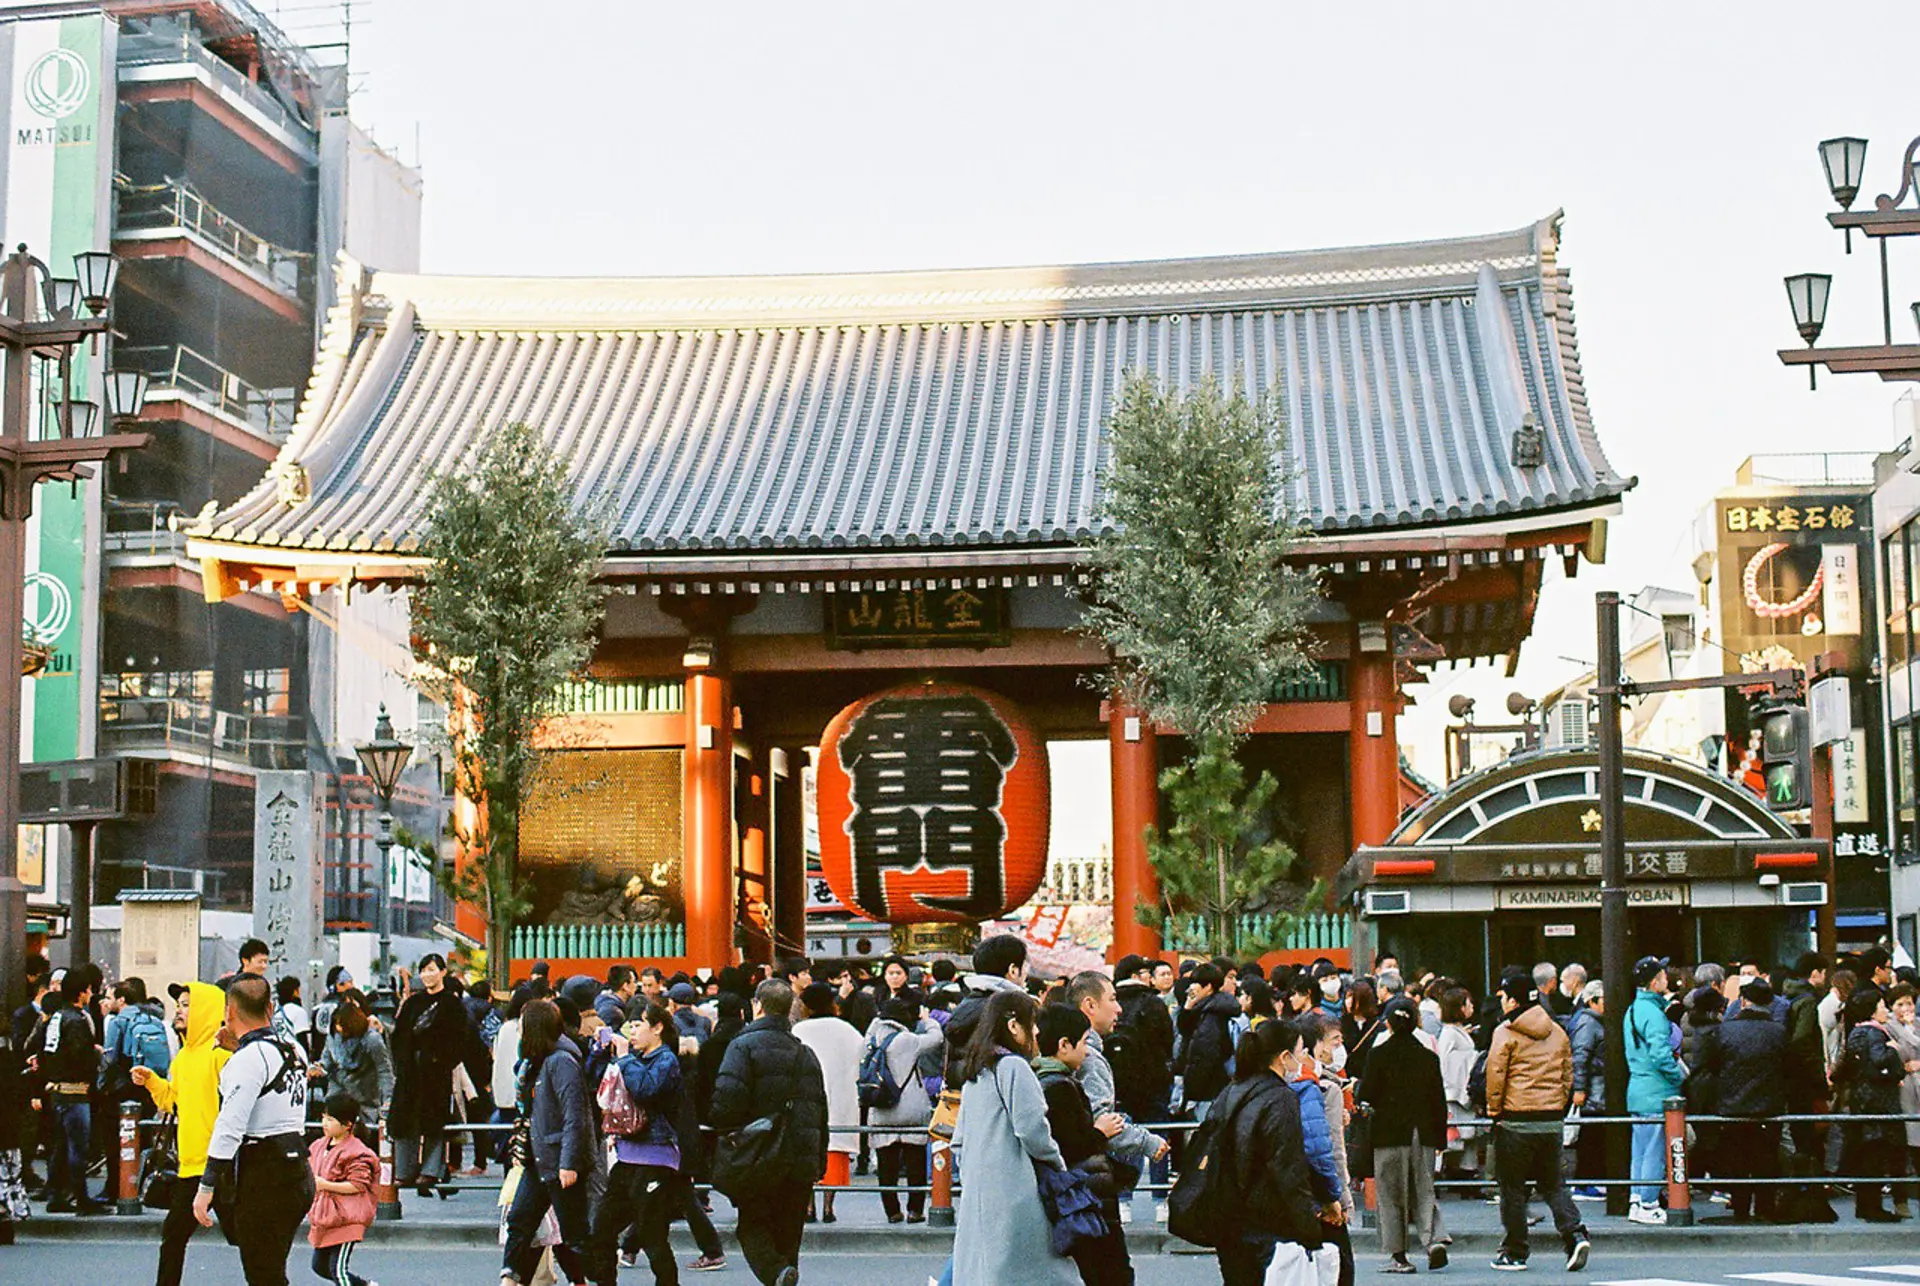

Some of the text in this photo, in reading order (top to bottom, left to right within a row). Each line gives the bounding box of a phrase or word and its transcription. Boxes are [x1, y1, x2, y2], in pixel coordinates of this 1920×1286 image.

[17, 124, 92, 145] MATSUI
[1836, 832, 1881, 856] 直送
[1510, 889, 1602, 904] KAMINARIMO
